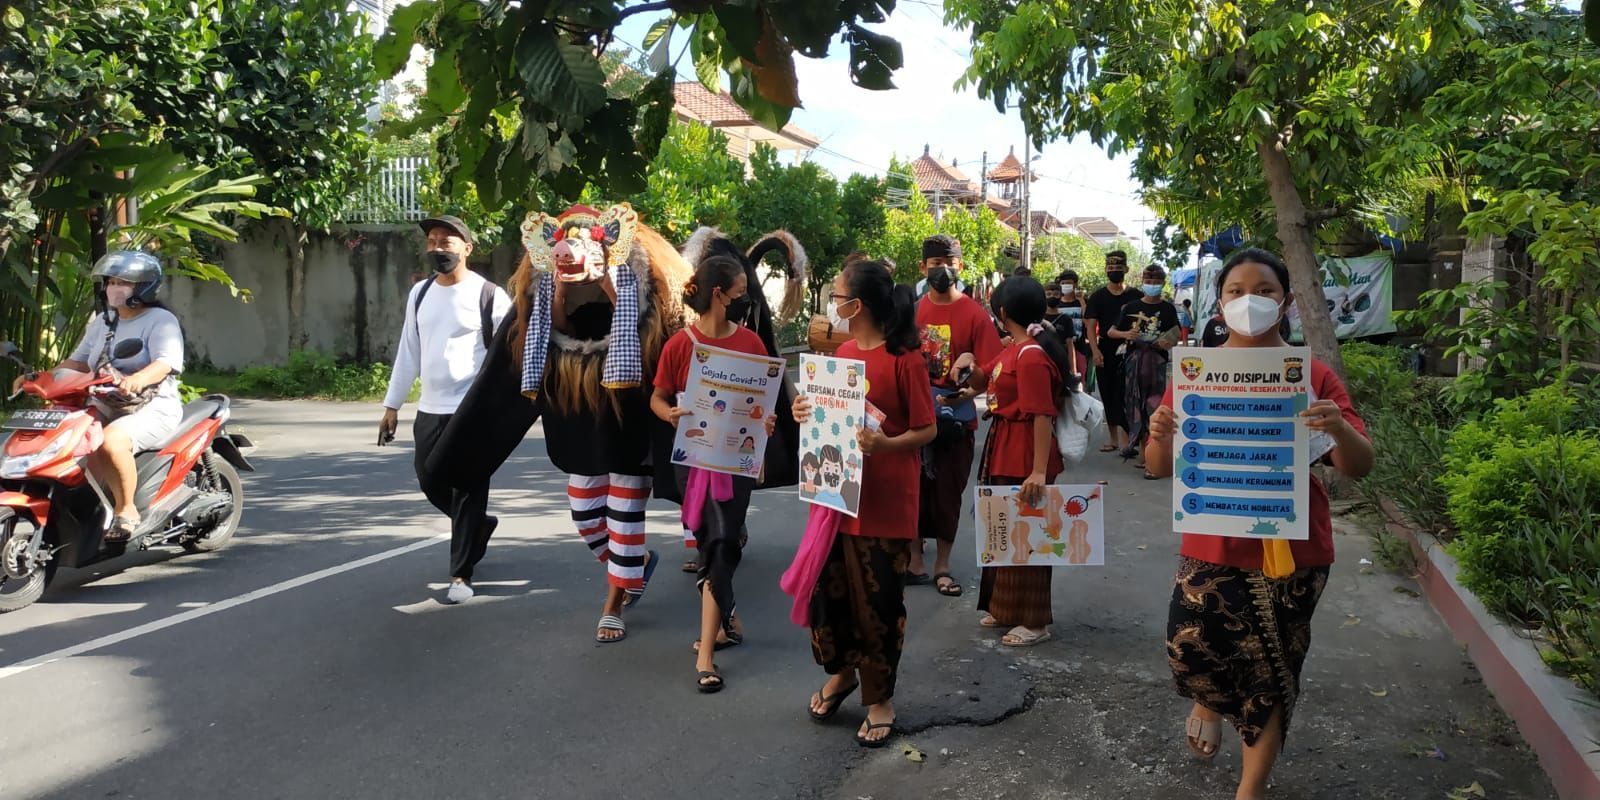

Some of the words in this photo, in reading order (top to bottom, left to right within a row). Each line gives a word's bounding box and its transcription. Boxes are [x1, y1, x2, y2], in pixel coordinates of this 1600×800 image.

[701, 365, 727, 381] Gejala
[730, 372, 768, 387] Covid-19
[1205, 372, 1230, 383] AYO
[1233, 372, 1281, 384] DISIPLIN
[806, 384, 837, 398] BERSAMA
[1178, 384, 1212, 392] MENTAATI
[1213, 384, 1248, 393] PROTOKOL
[1209, 402, 1246, 412] MENCUCI
[1248, 403, 1283, 412] TANGAN
[1189, 423, 1198, 434] 2
[1208, 426, 1246, 436] MEMAKAI
[1248, 427, 1282, 436] MASKER
[1189, 446, 1198, 458] 3
[1207, 451, 1247, 461] MENJAGA
[1249, 452, 1278, 461] JARAK
[1188, 471, 1197, 483] 4
[1206, 475, 1245, 484] MENJAUHI
[1245, 476, 1292, 487] KERUMUNAN
[1188, 499, 1198, 510] 5
[1205, 502, 1249, 512] MEMBATASI
[1250, 504, 1290, 513] MOBILITAS
[998, 512, 1007, 552] Covid-19
